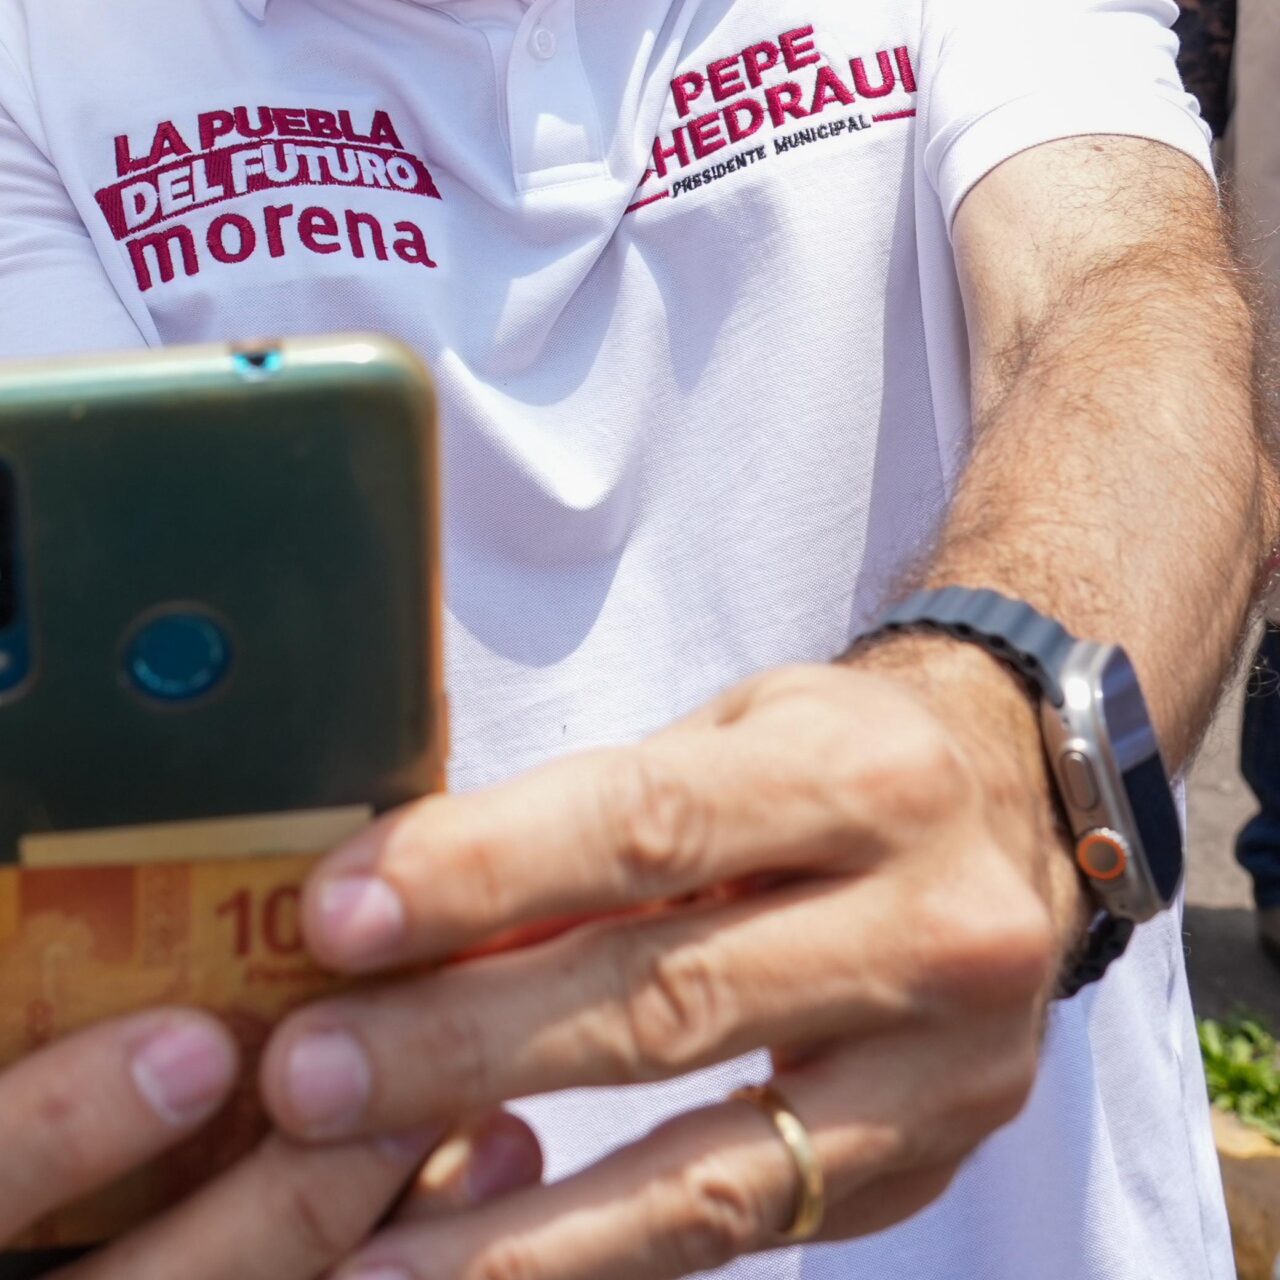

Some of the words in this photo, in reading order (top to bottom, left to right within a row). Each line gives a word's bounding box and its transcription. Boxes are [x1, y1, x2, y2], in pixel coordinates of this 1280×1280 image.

[670, 24, 821, 118] PEPE
[114, 120, 192, 178] LA
[198, 106, 405, 150] PUEBLA
[637, 46, 917, 187] HEDRAUI
[672, 145, 767, 198] PRESIDENTE
[773, 114, 871, 155] MUNICIPAL
[120, 160, 224, 230] DEL
[229, 143, 419, 194] FUTURO
[126, 203, 438, 292] morena
